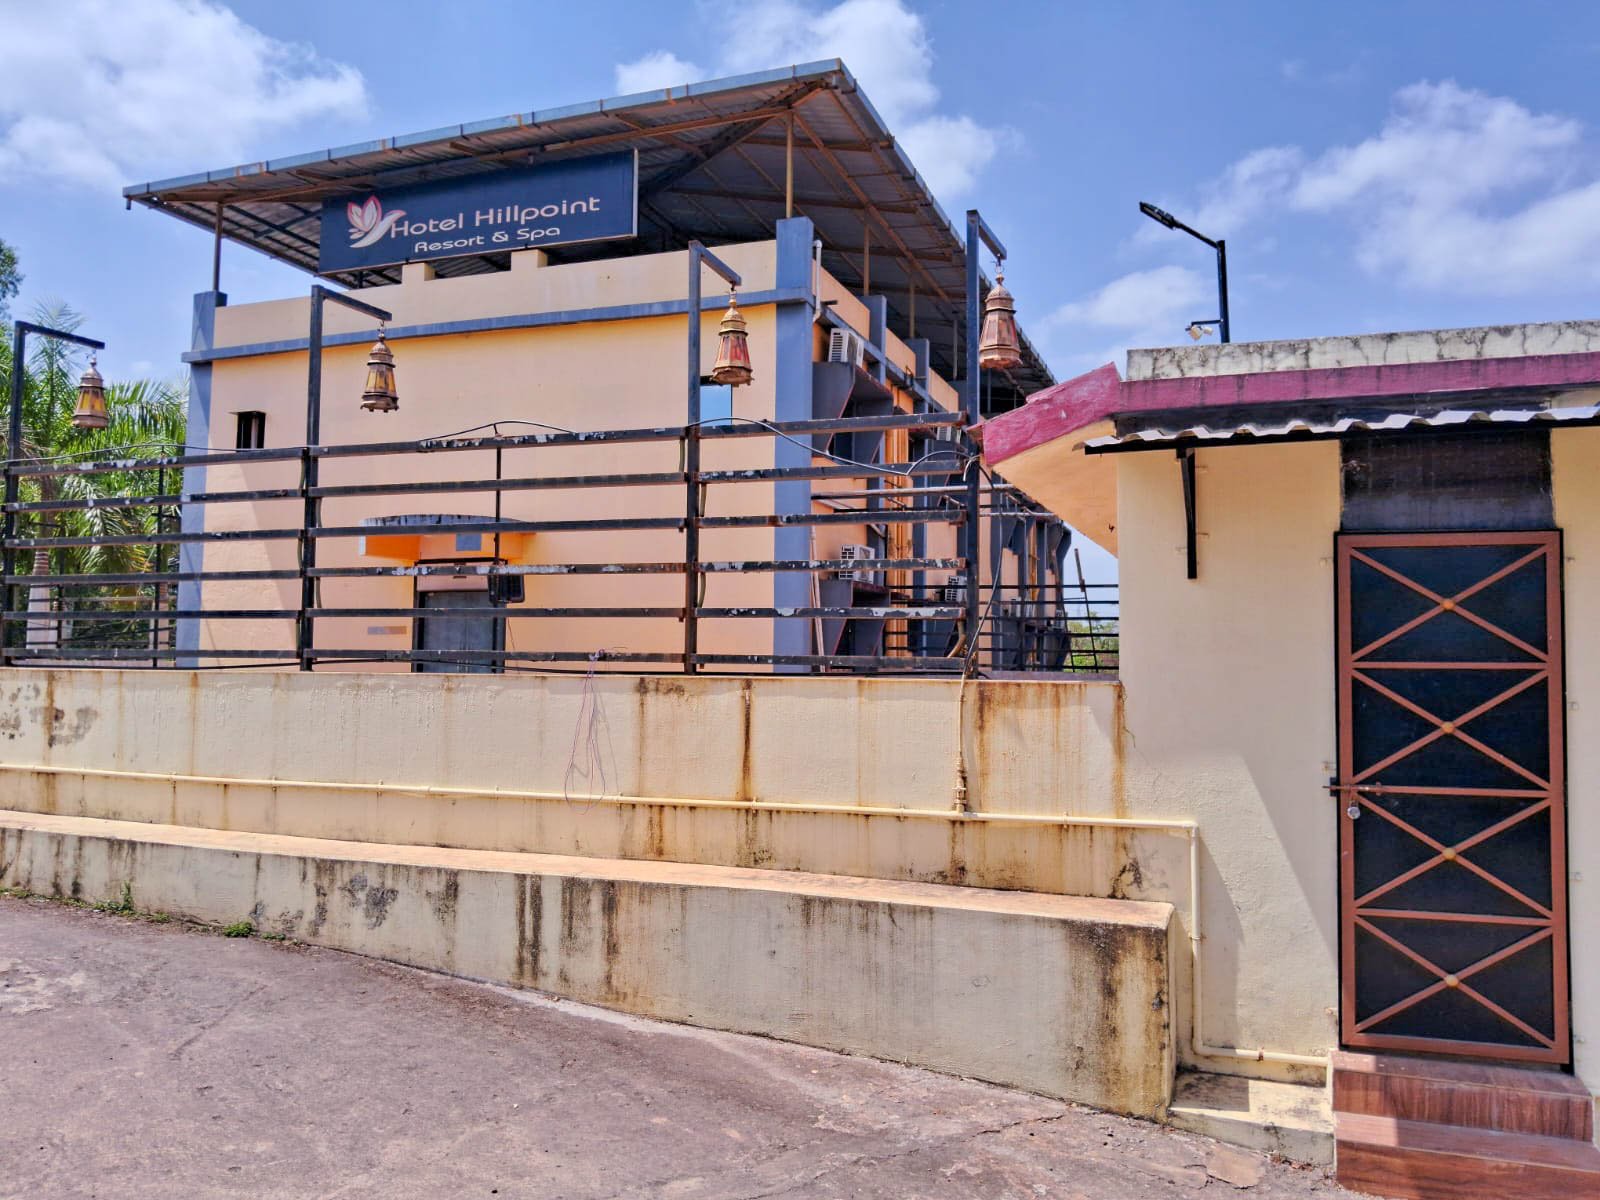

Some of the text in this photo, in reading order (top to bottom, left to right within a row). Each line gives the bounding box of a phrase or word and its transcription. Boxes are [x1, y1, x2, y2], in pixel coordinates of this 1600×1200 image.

[390, 196, 600, 239] Hotel Hillpoint
[414, 225, 561, 253] Resort & Spa
